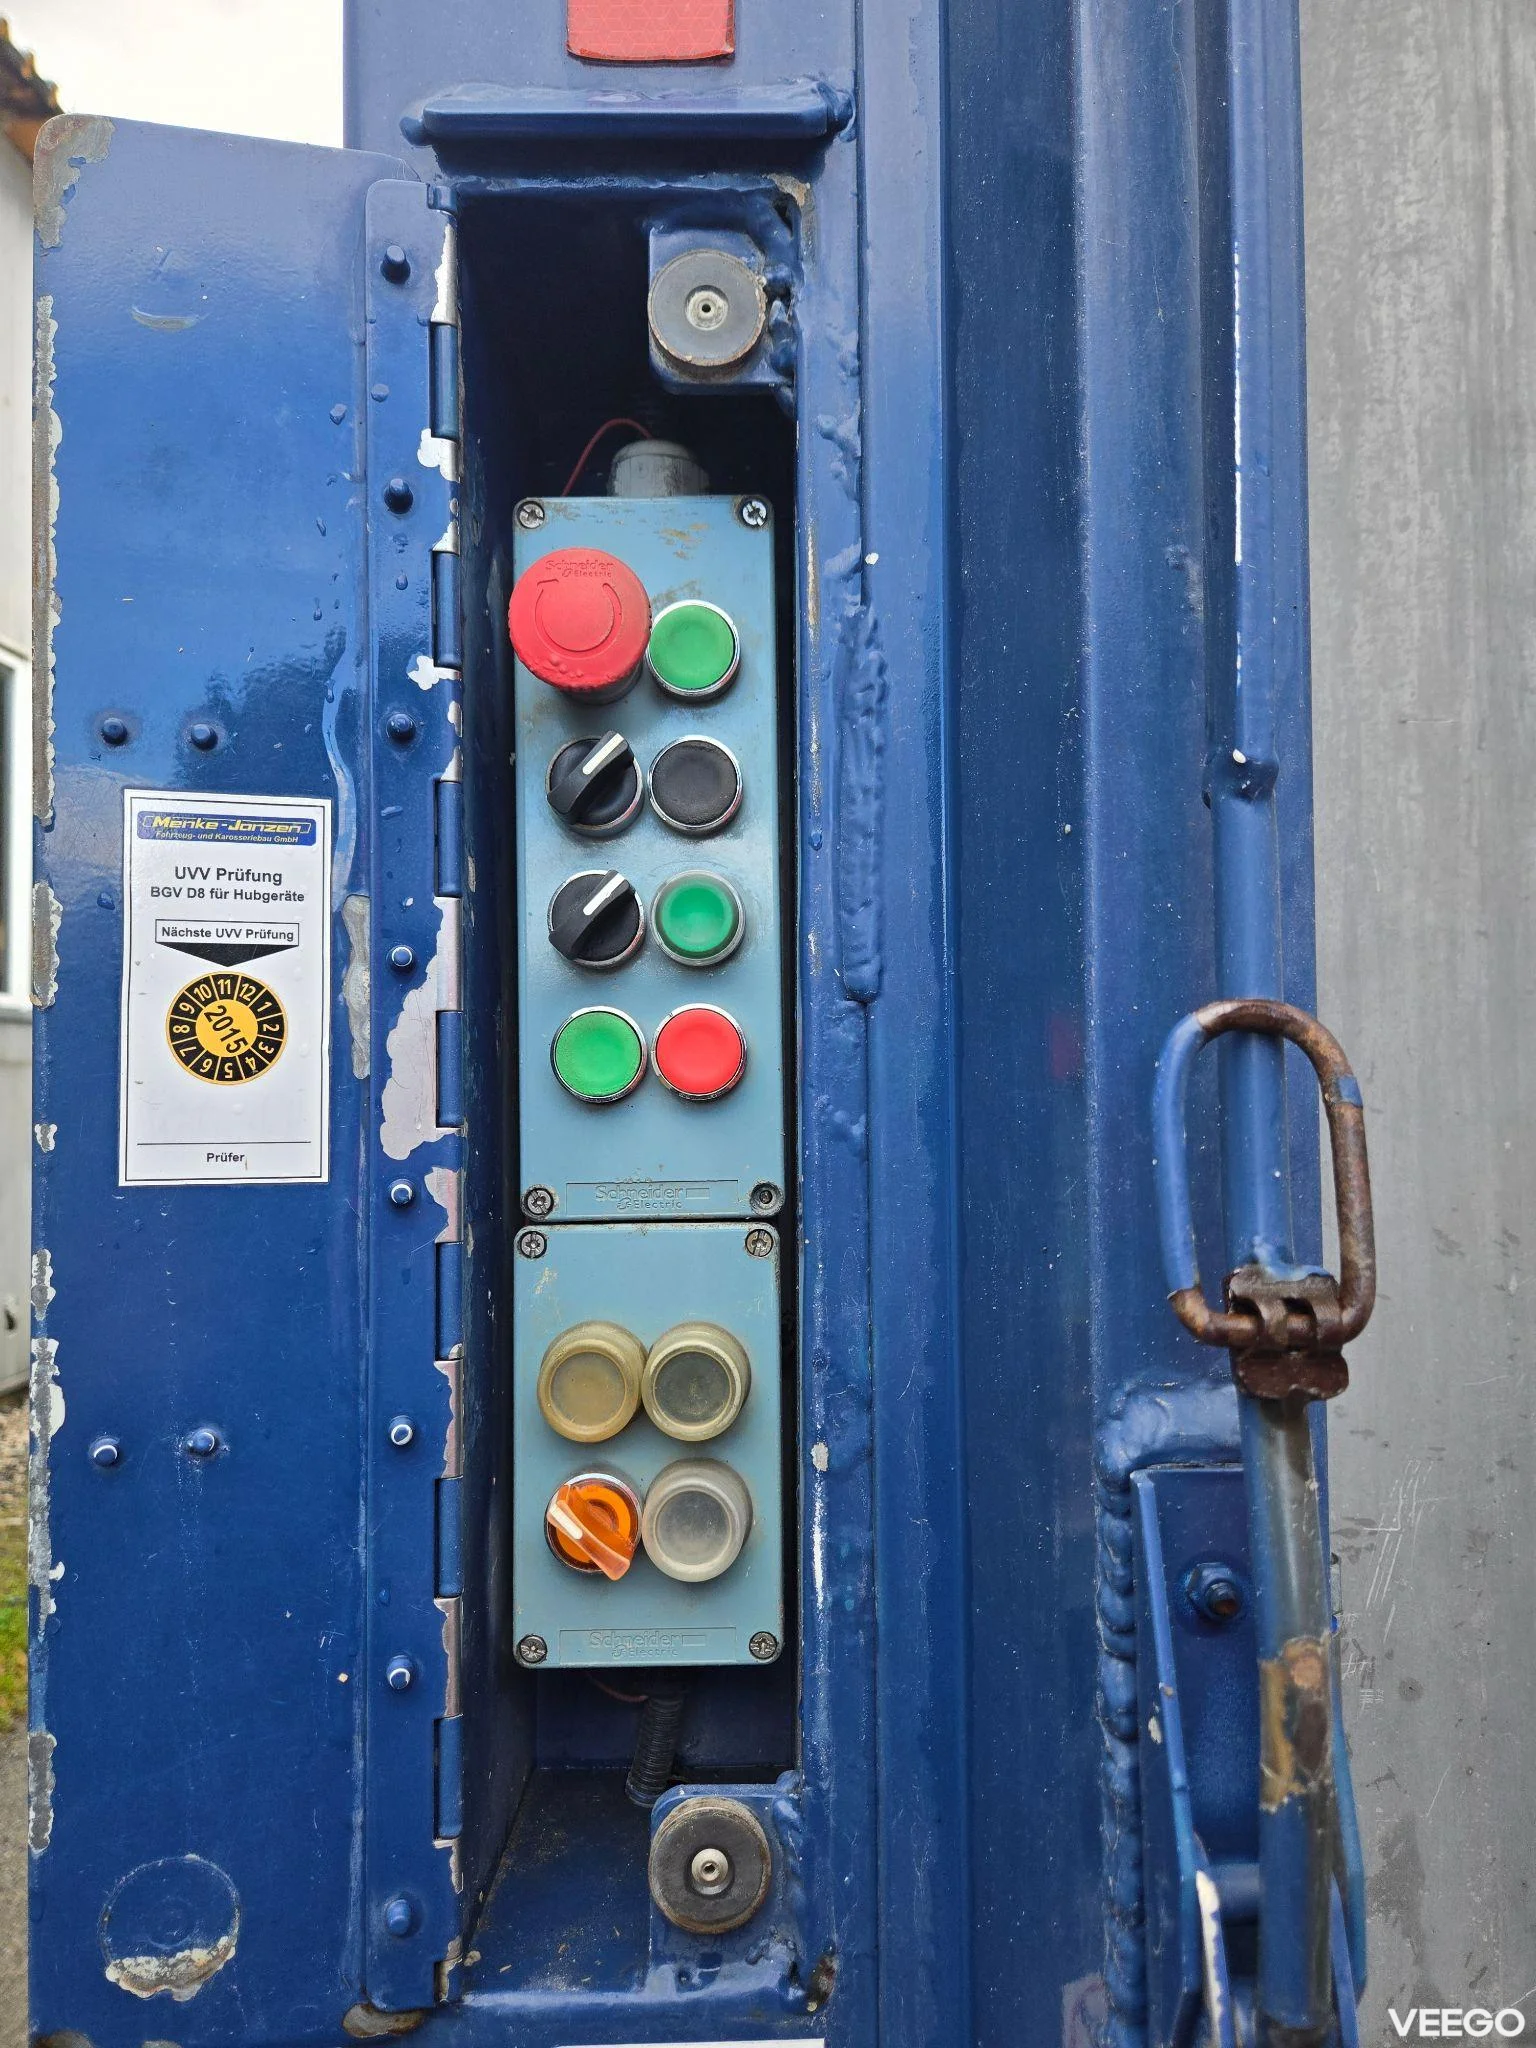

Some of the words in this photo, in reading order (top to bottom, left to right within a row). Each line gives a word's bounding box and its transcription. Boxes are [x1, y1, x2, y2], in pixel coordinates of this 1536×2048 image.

[545, 559, 614, 570] Schneider
[198, 833, 214, 841] und
[214, 833, 272, 843] Karosseriebau
[274, 835, 299, 844] GmbH
[174, 866, 211, 880] UVV
[216, 867, 283, 886] Prüfung
[150, 886, 183, 898] BGV
[187, 887, 205, 899] D8
[209, 888, 230, 900] für
[233, 889, 305, 904] Hubgeräte
[161, 926, 212, 938] Nächste
[215, 928, 243, 939] UVV
[245, 929, 294, 942] Prüfung
[193, 983, 213, 1002] 10
[217, 978, 231, 995] 11
[239, 982, 257, 1000] 12
[179, 1002, 195, 1015] 9
[257, 1001, 272, 1012] 1
[172, 1024, 191, 1034] 8
[203, 1004, 249, 1054] 2015
[262, 1023, 280, 1033] 2
[179, 1045, 197, 1057] 7
[258, 1042, 275, 1055] 3
[224, 1062, 233, 1079] 5
[206, 1152, 246, 1163] Prüfer
[595, 1184, 684, 1200] Schneider
[633, 1200, 683, 1210] Electric
[589, 1631, 683, 1648] Schneider
